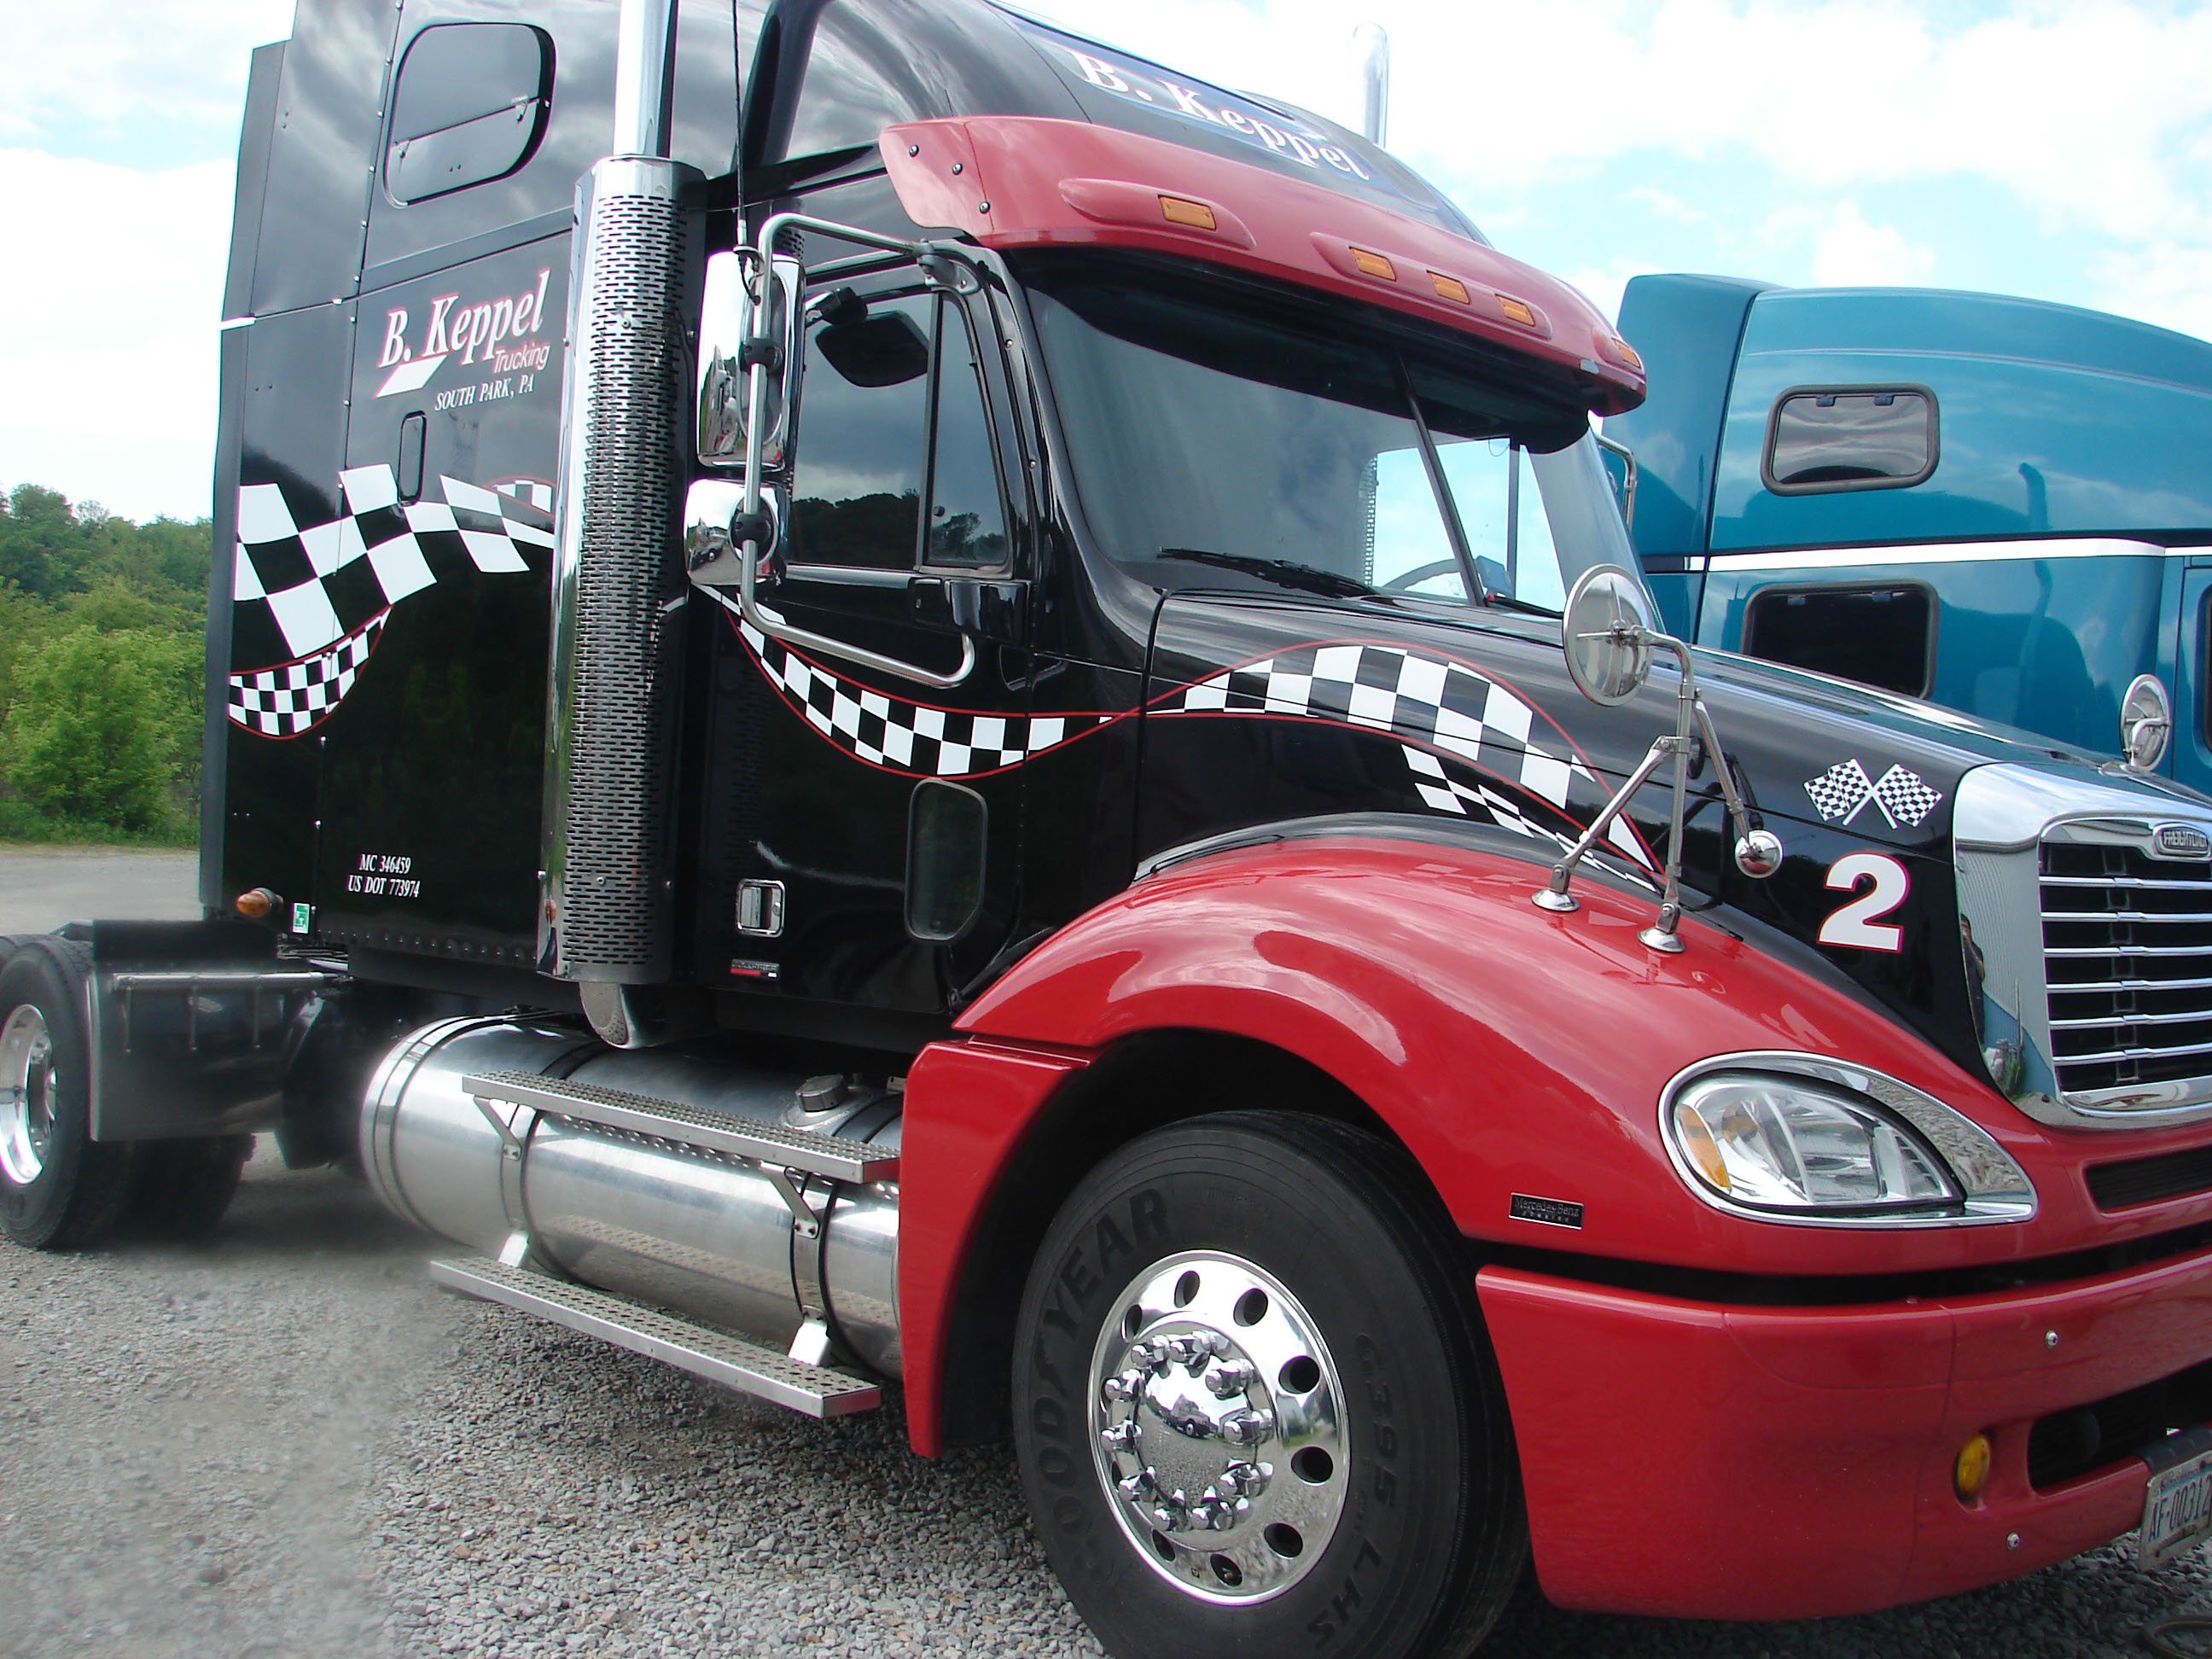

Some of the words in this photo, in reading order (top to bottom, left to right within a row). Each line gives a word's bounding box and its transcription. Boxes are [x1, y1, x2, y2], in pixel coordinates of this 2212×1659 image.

[1066, 49, 1152, 102] B.
[1155, 79, 1370, 182] Keppel
[378, 306, 412, 368] B.
[422, 267, 551, 365] Keppel
[492, 341, 550, 374] Trucking
[434, 386, 476, 411] SOUTH
[479, 377, 515, 403] PARK,
[519, 373, 535, 393] PA
[358, 853, 377, 871] MC
[380, 855, 411, 874] 346459
[347, 874, 363, 893] US
[364, 876, 387, 894] DOT
[388, 878, 421, 898] 773974
[1816, 851, 1911, 953] 2
